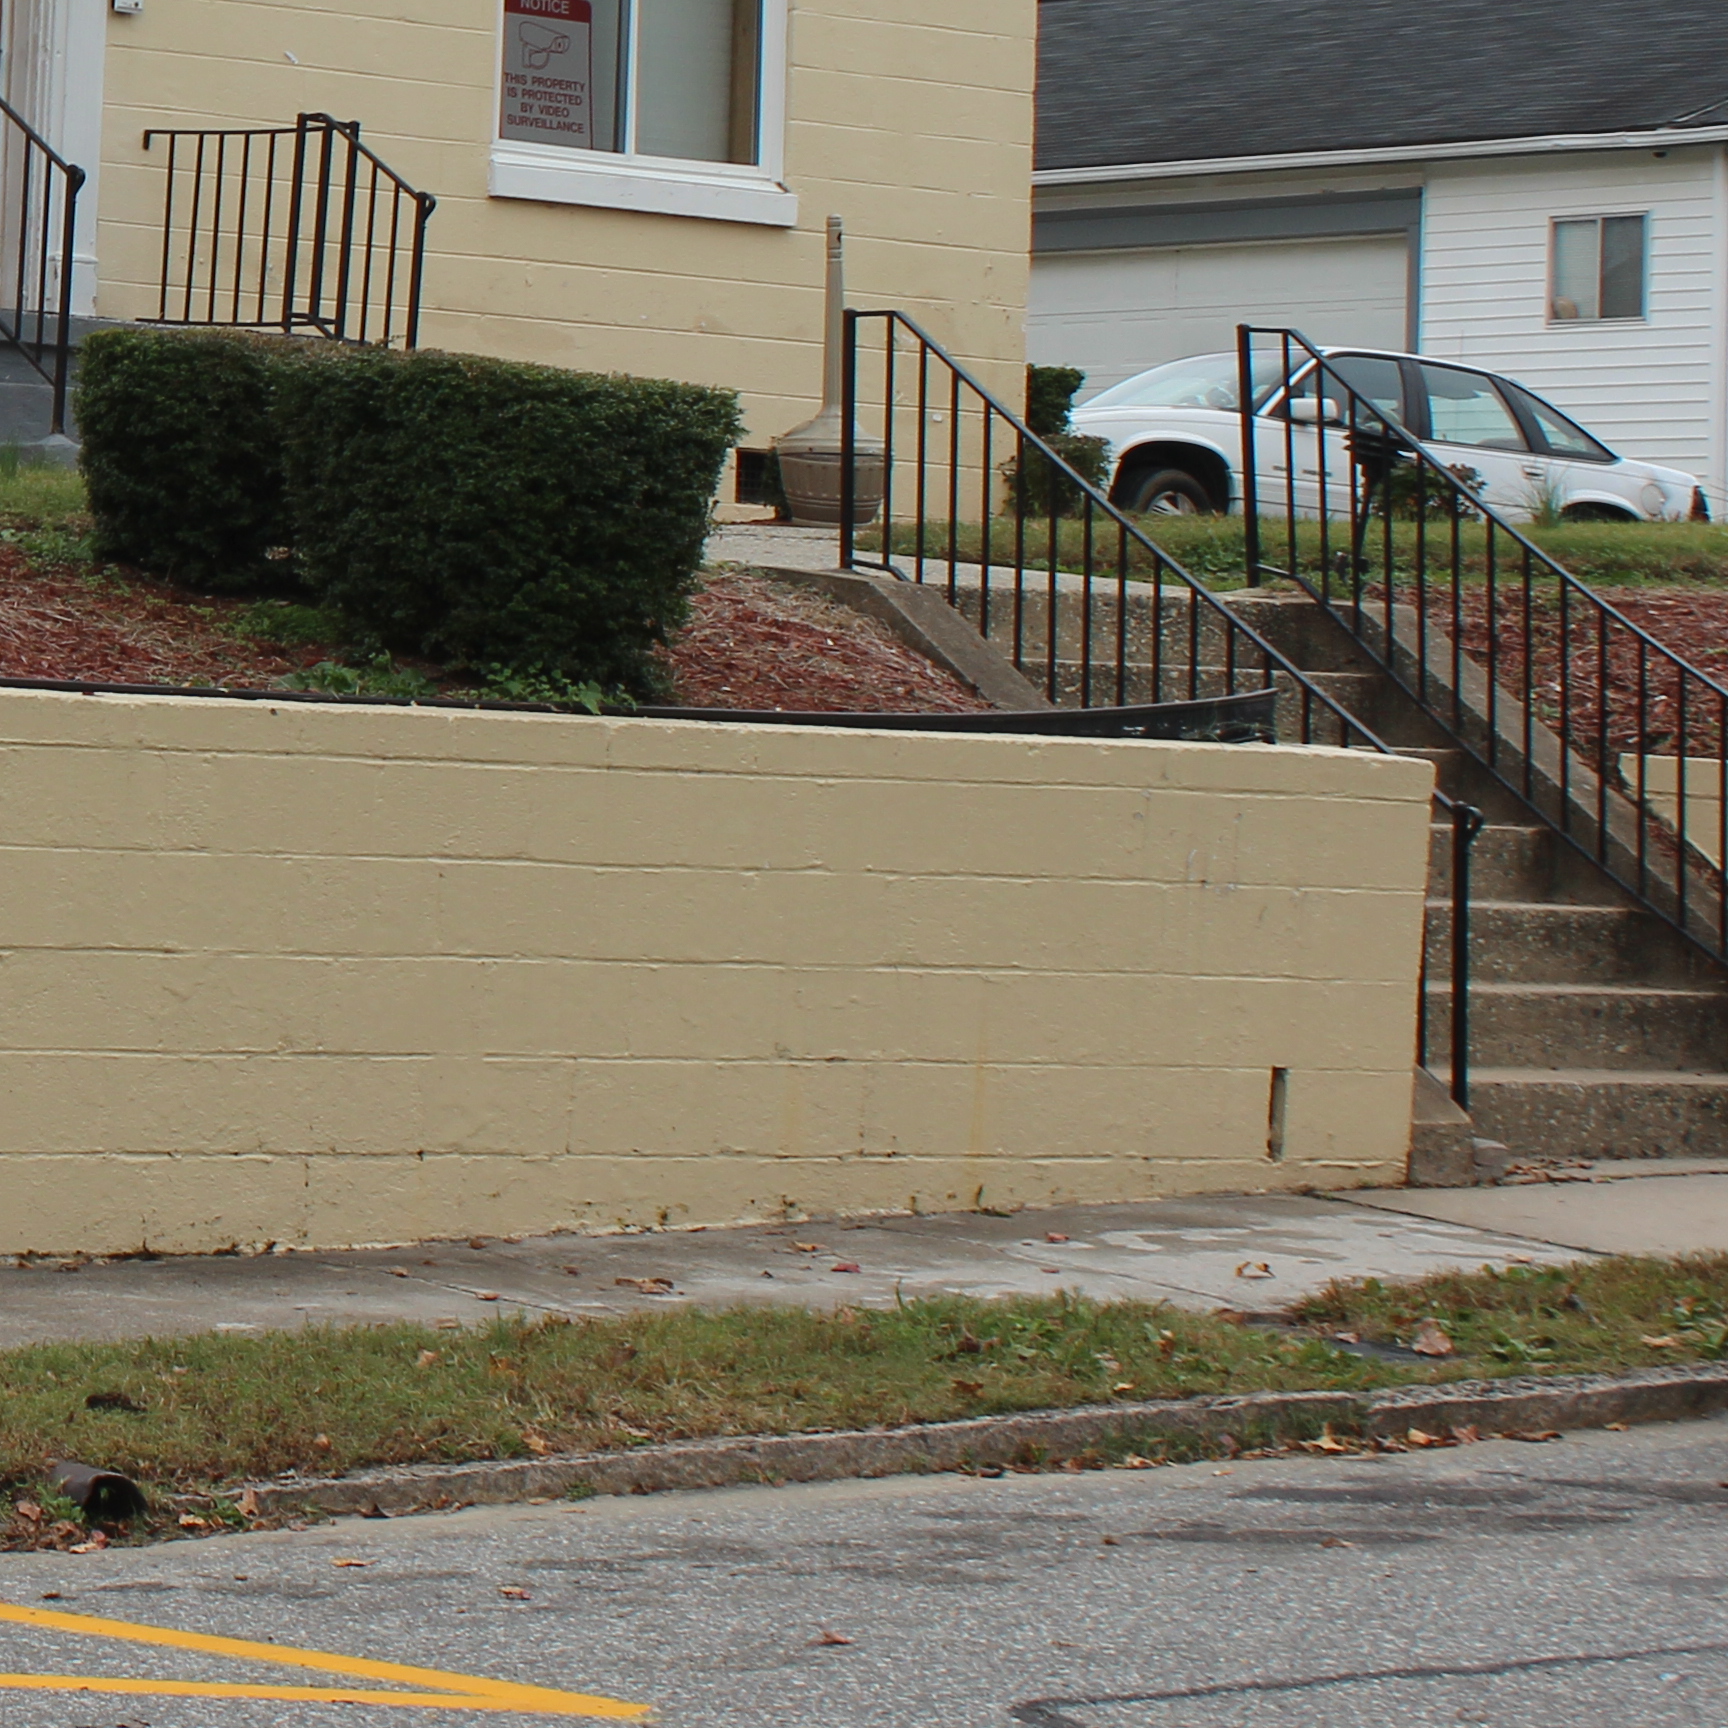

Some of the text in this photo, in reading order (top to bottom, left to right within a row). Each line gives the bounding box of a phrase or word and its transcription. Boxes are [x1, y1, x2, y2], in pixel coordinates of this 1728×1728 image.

[505, 72, 586, 93] THIS PROPERTY
[507, 87, 583, 106] IS PROTECTED
[520, 102, 570, 119] BY VIDEO
[507, 114, 585, 134] SURVEILLANCE
